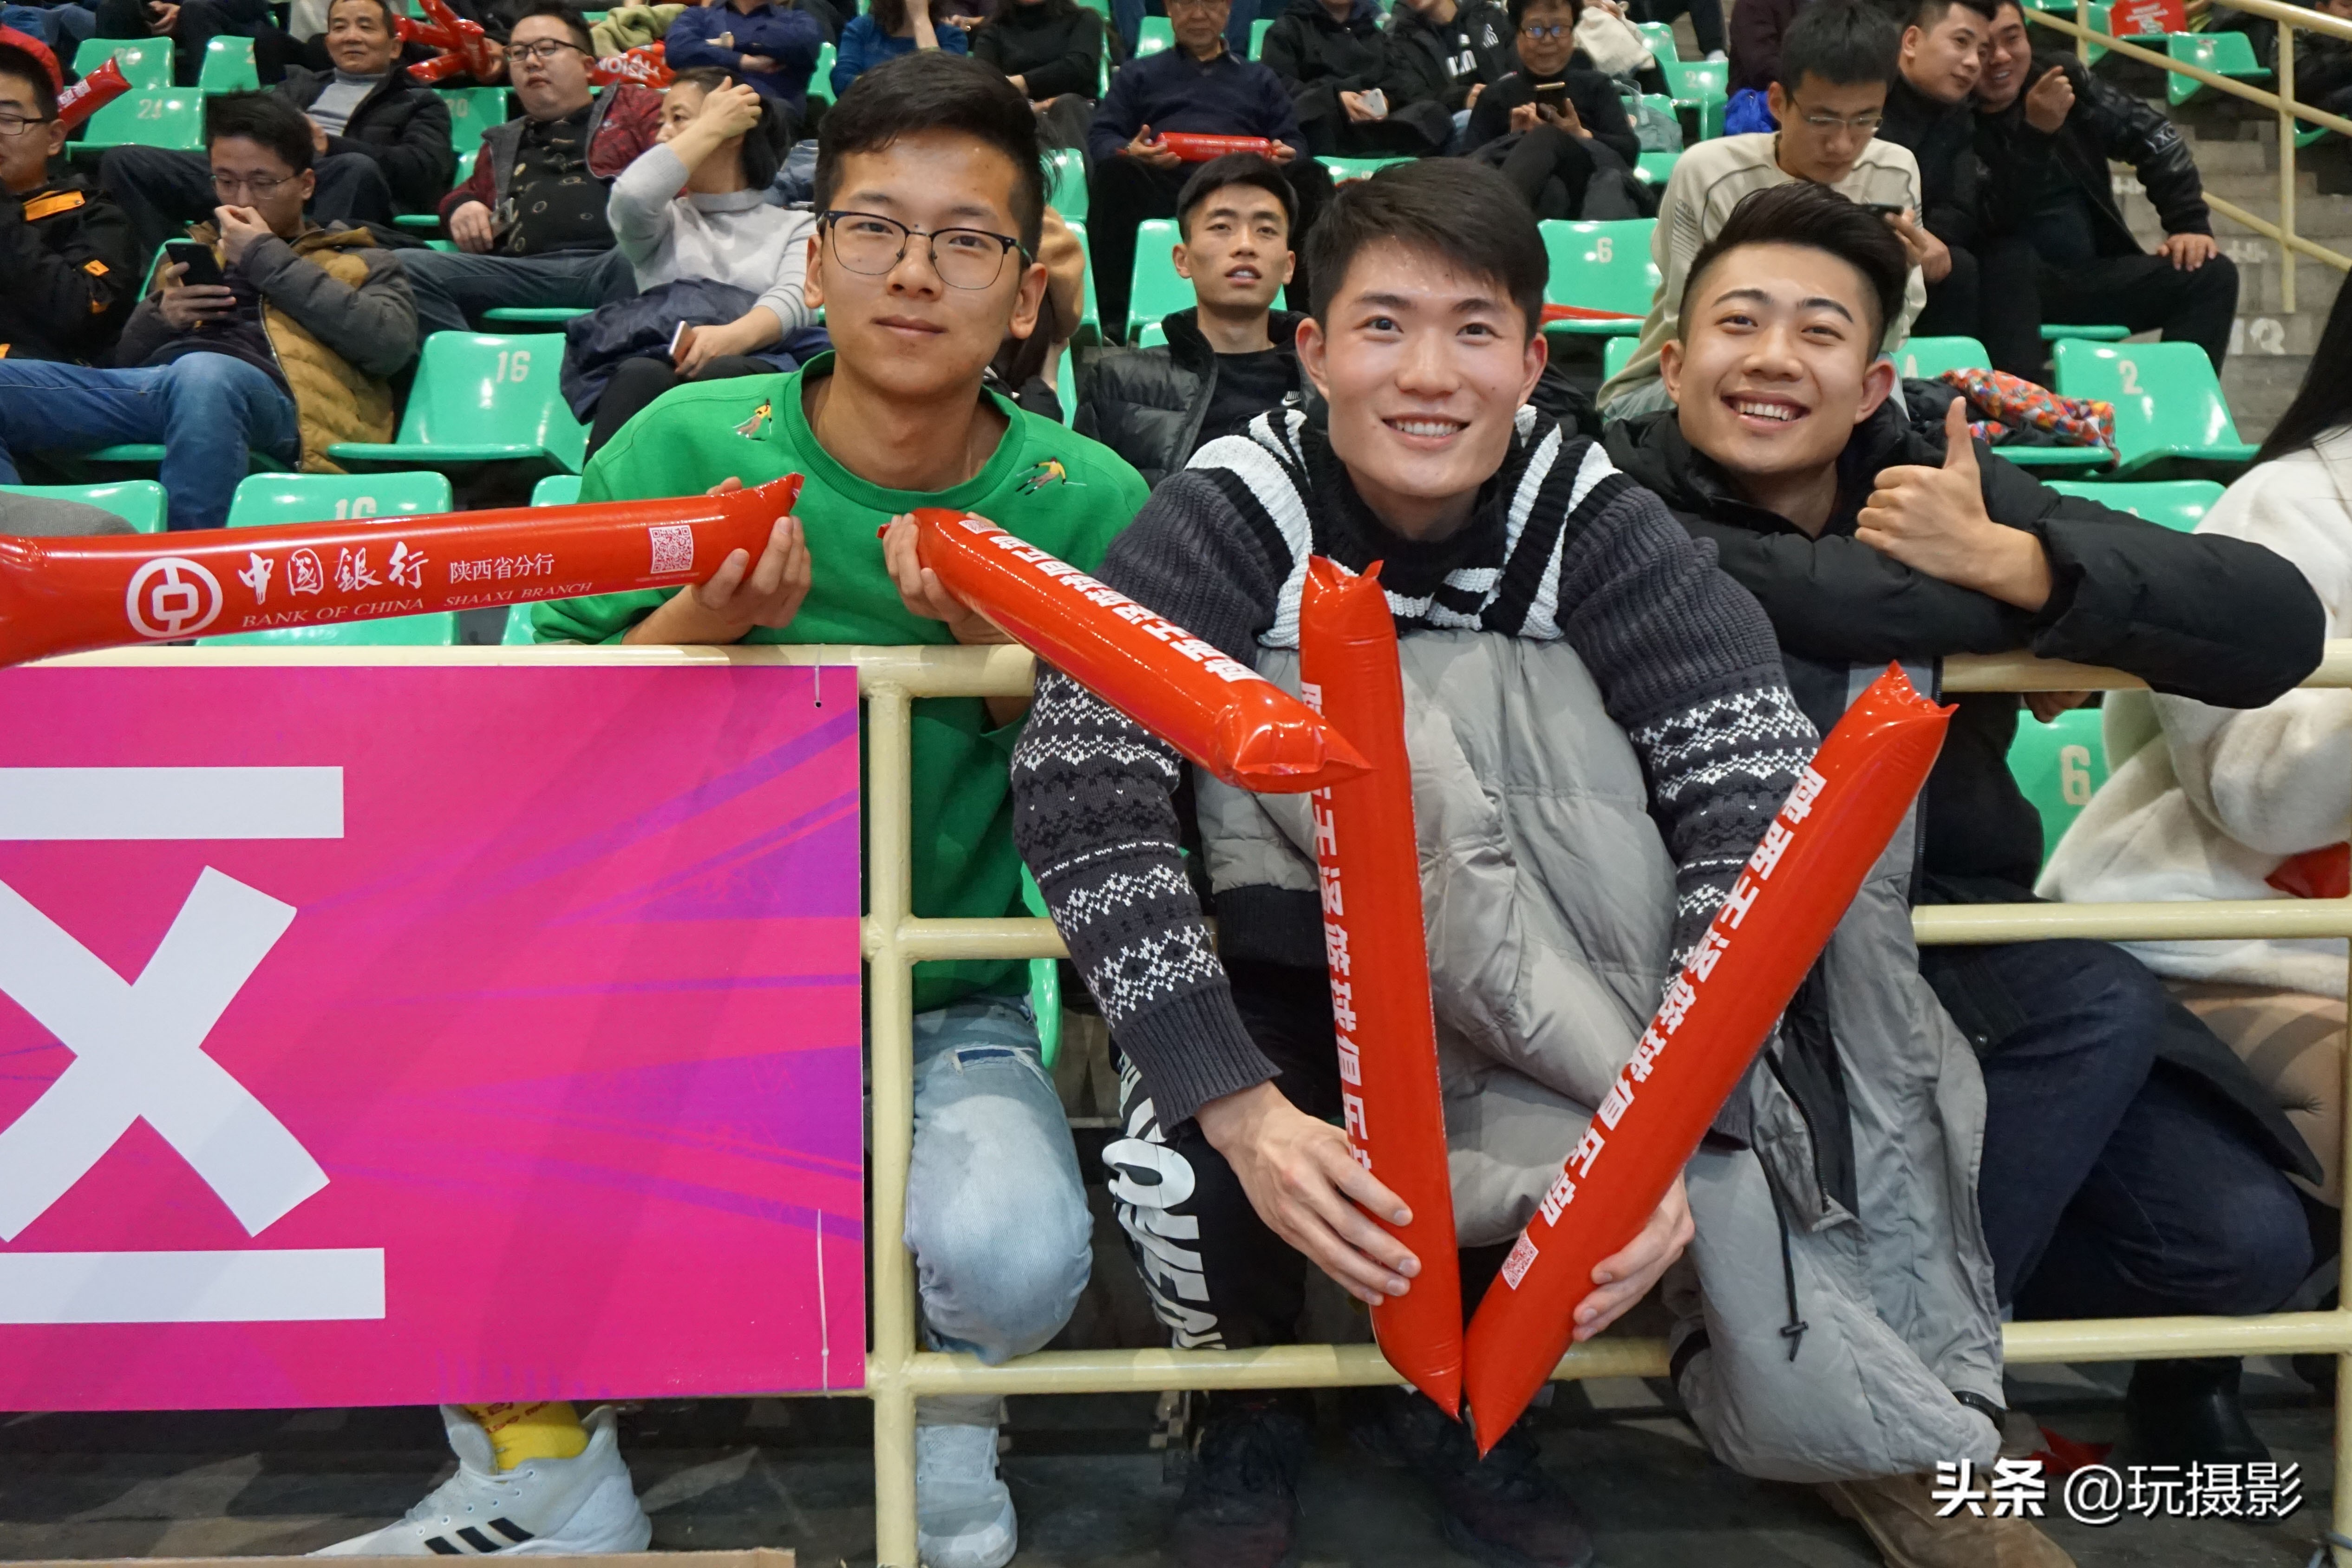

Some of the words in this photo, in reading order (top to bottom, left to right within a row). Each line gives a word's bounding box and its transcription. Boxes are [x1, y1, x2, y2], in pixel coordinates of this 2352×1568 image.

[1597, 237, 1613, 263] 6
[496, 351, 531, 382] 16
[2119, 360, 2143, 394] 2
[238, 541, 429, 605] 中國銀行
[450, 553, 555, 584] 陕西省分行
[444, 590, 514, 606] SHAAXI
[521, 582, 593, 599] BRANCH
[242, 609, 309, 627] BANK
[316, 606, 349, 620] OF
[353, 598, 424, 616] CHINA
[2061, 745, 2091, 805] 6
[0, 766, 386, 1324] 区
